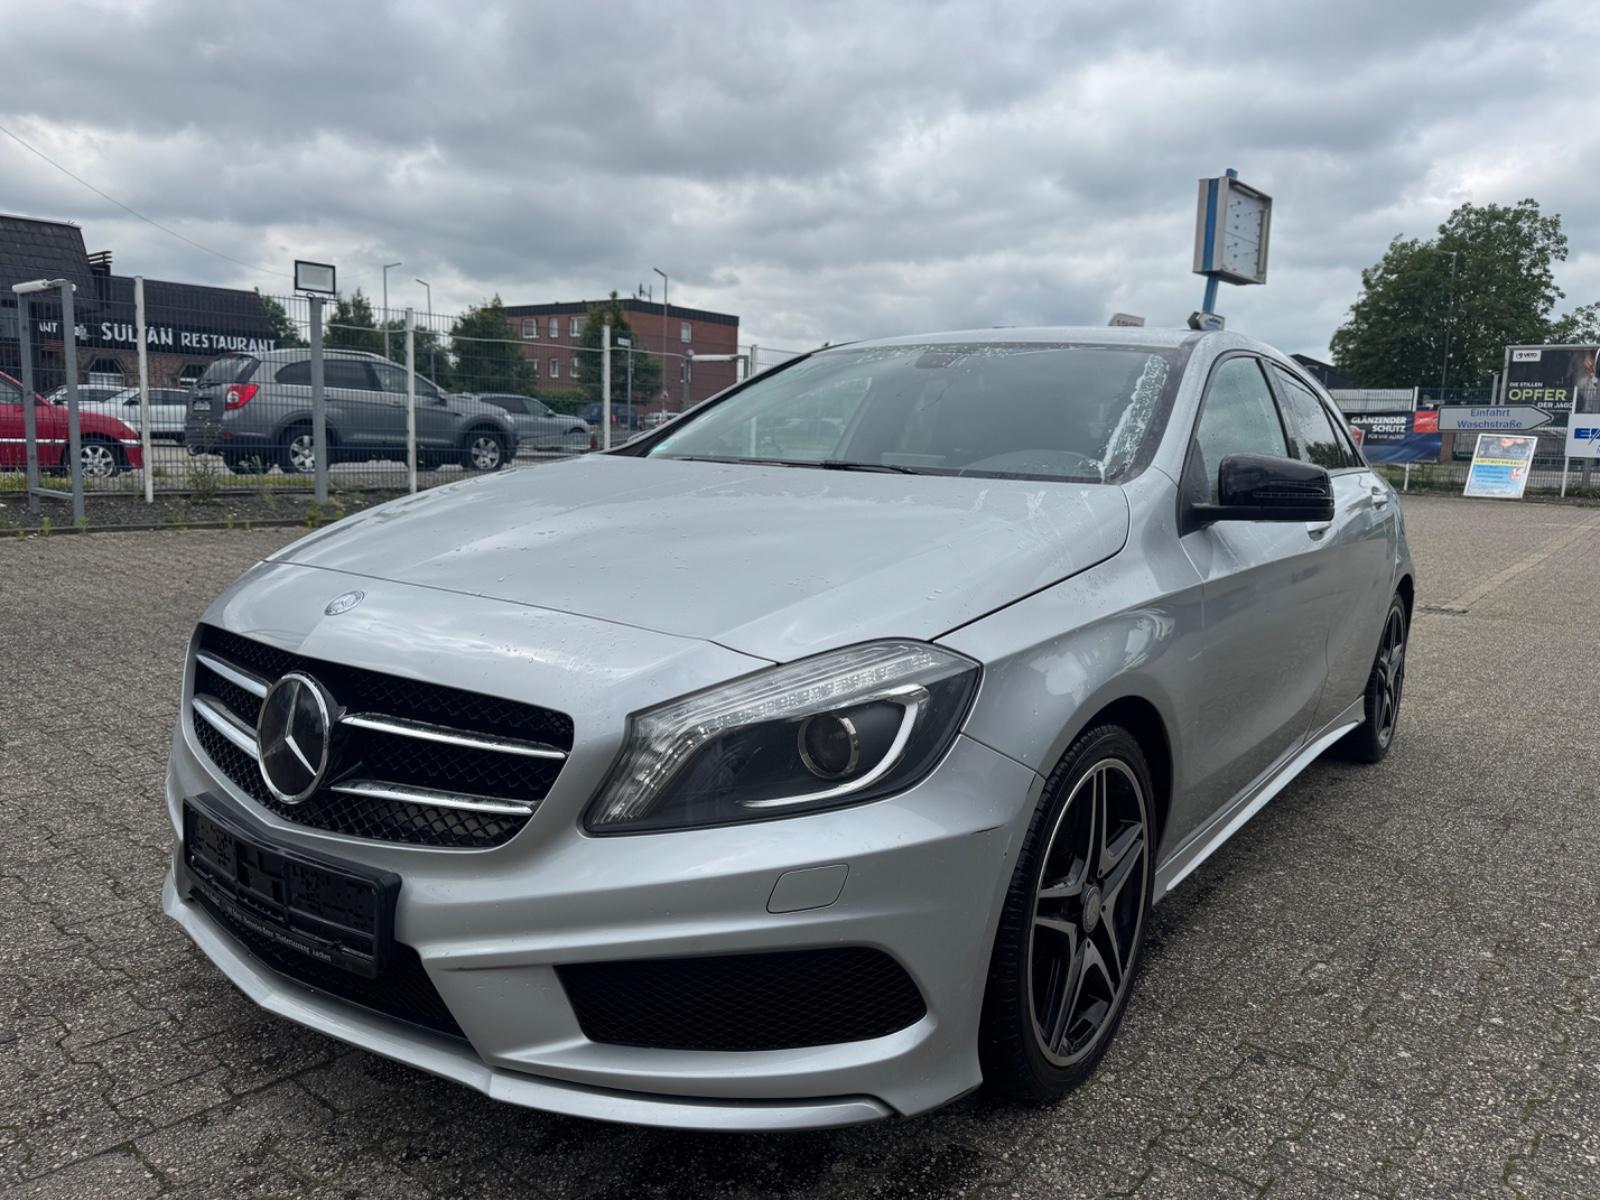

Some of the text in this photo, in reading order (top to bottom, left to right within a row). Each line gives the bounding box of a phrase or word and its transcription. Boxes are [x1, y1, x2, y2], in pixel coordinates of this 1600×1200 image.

[181, 332, 276, 351] RESTAURANT
[1509, 389, 1567, 400] OPFER
[1537, 401, 1553, 409] DER
[1470, 408, 1511, 417] Einfahrt
[1351, 416, 1407, 424] GLÄNZENDER
[1457, 419, 1522, 429] Waschstraße
[1372, 425, 1406, 433] SCHUTZ
